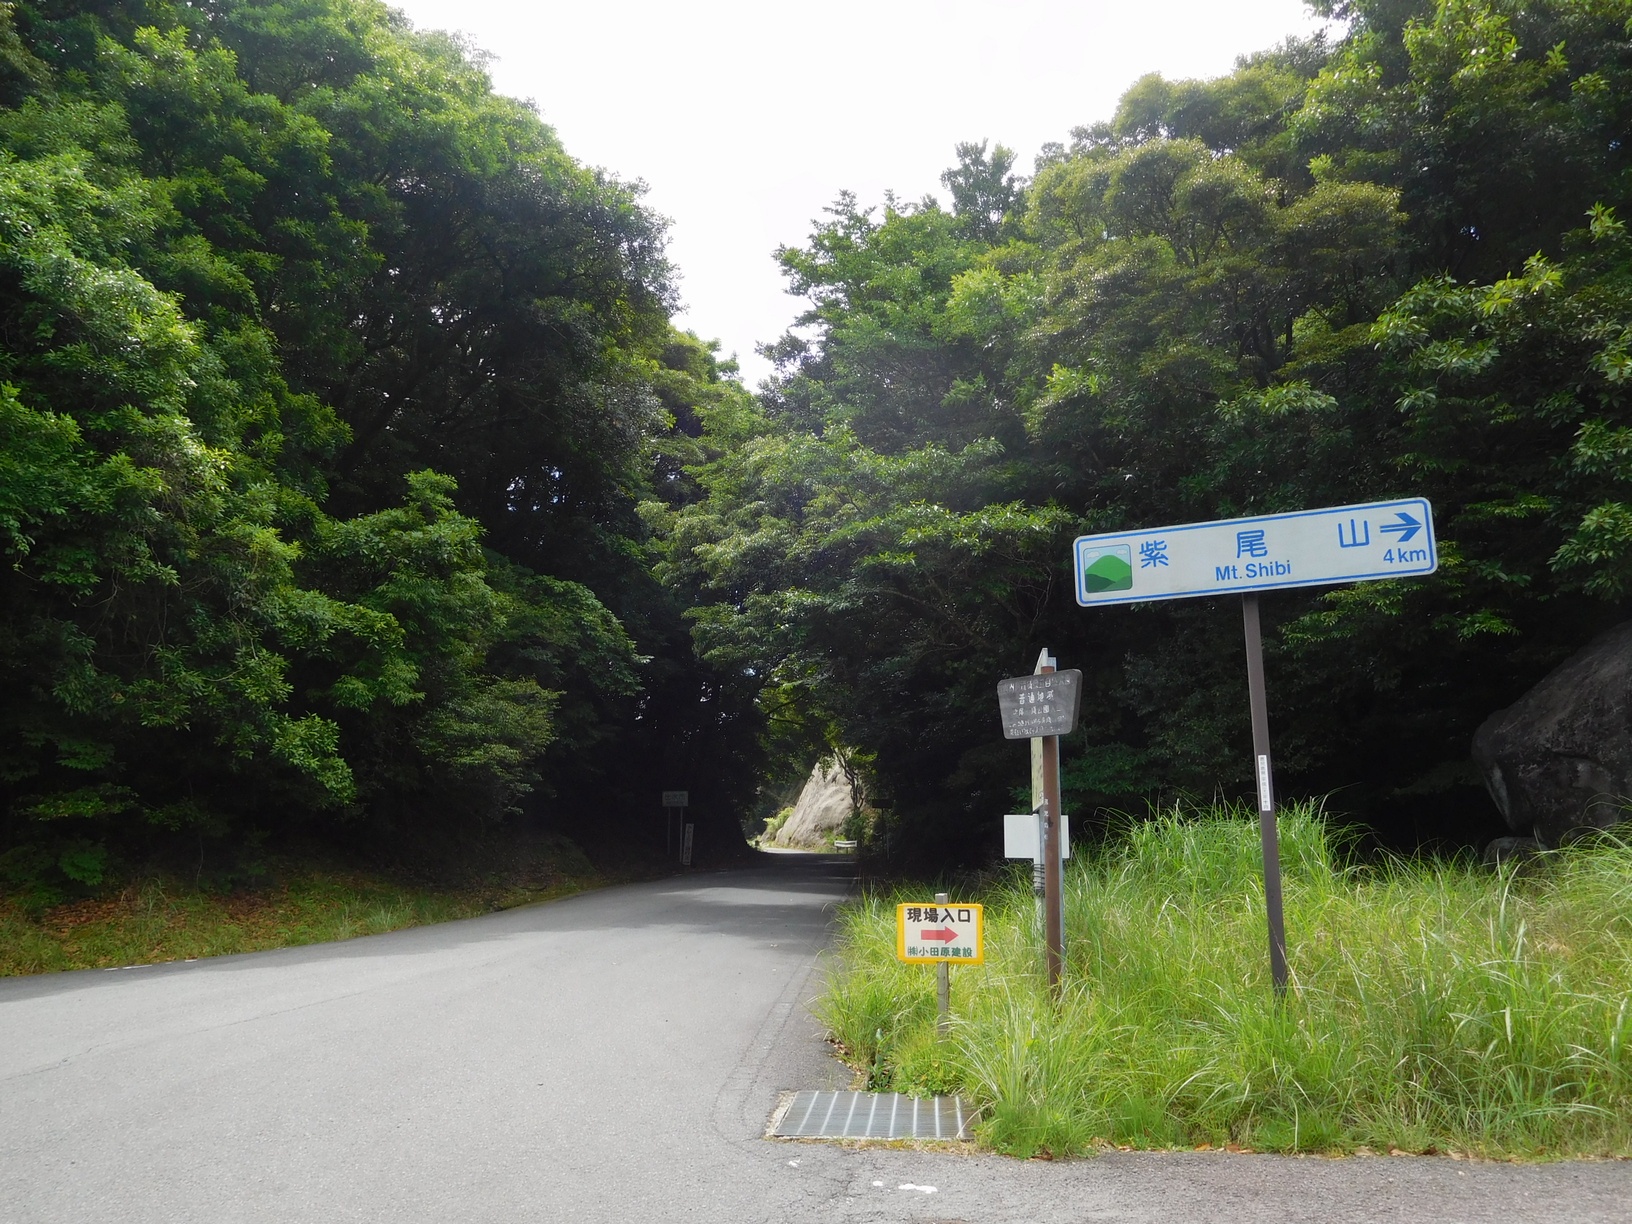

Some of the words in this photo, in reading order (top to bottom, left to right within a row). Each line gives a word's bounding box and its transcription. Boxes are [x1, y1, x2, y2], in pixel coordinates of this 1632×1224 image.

[1139, 519, 1370, 569] 紫尾山
[907, 908, 970, 923] 現場入口
